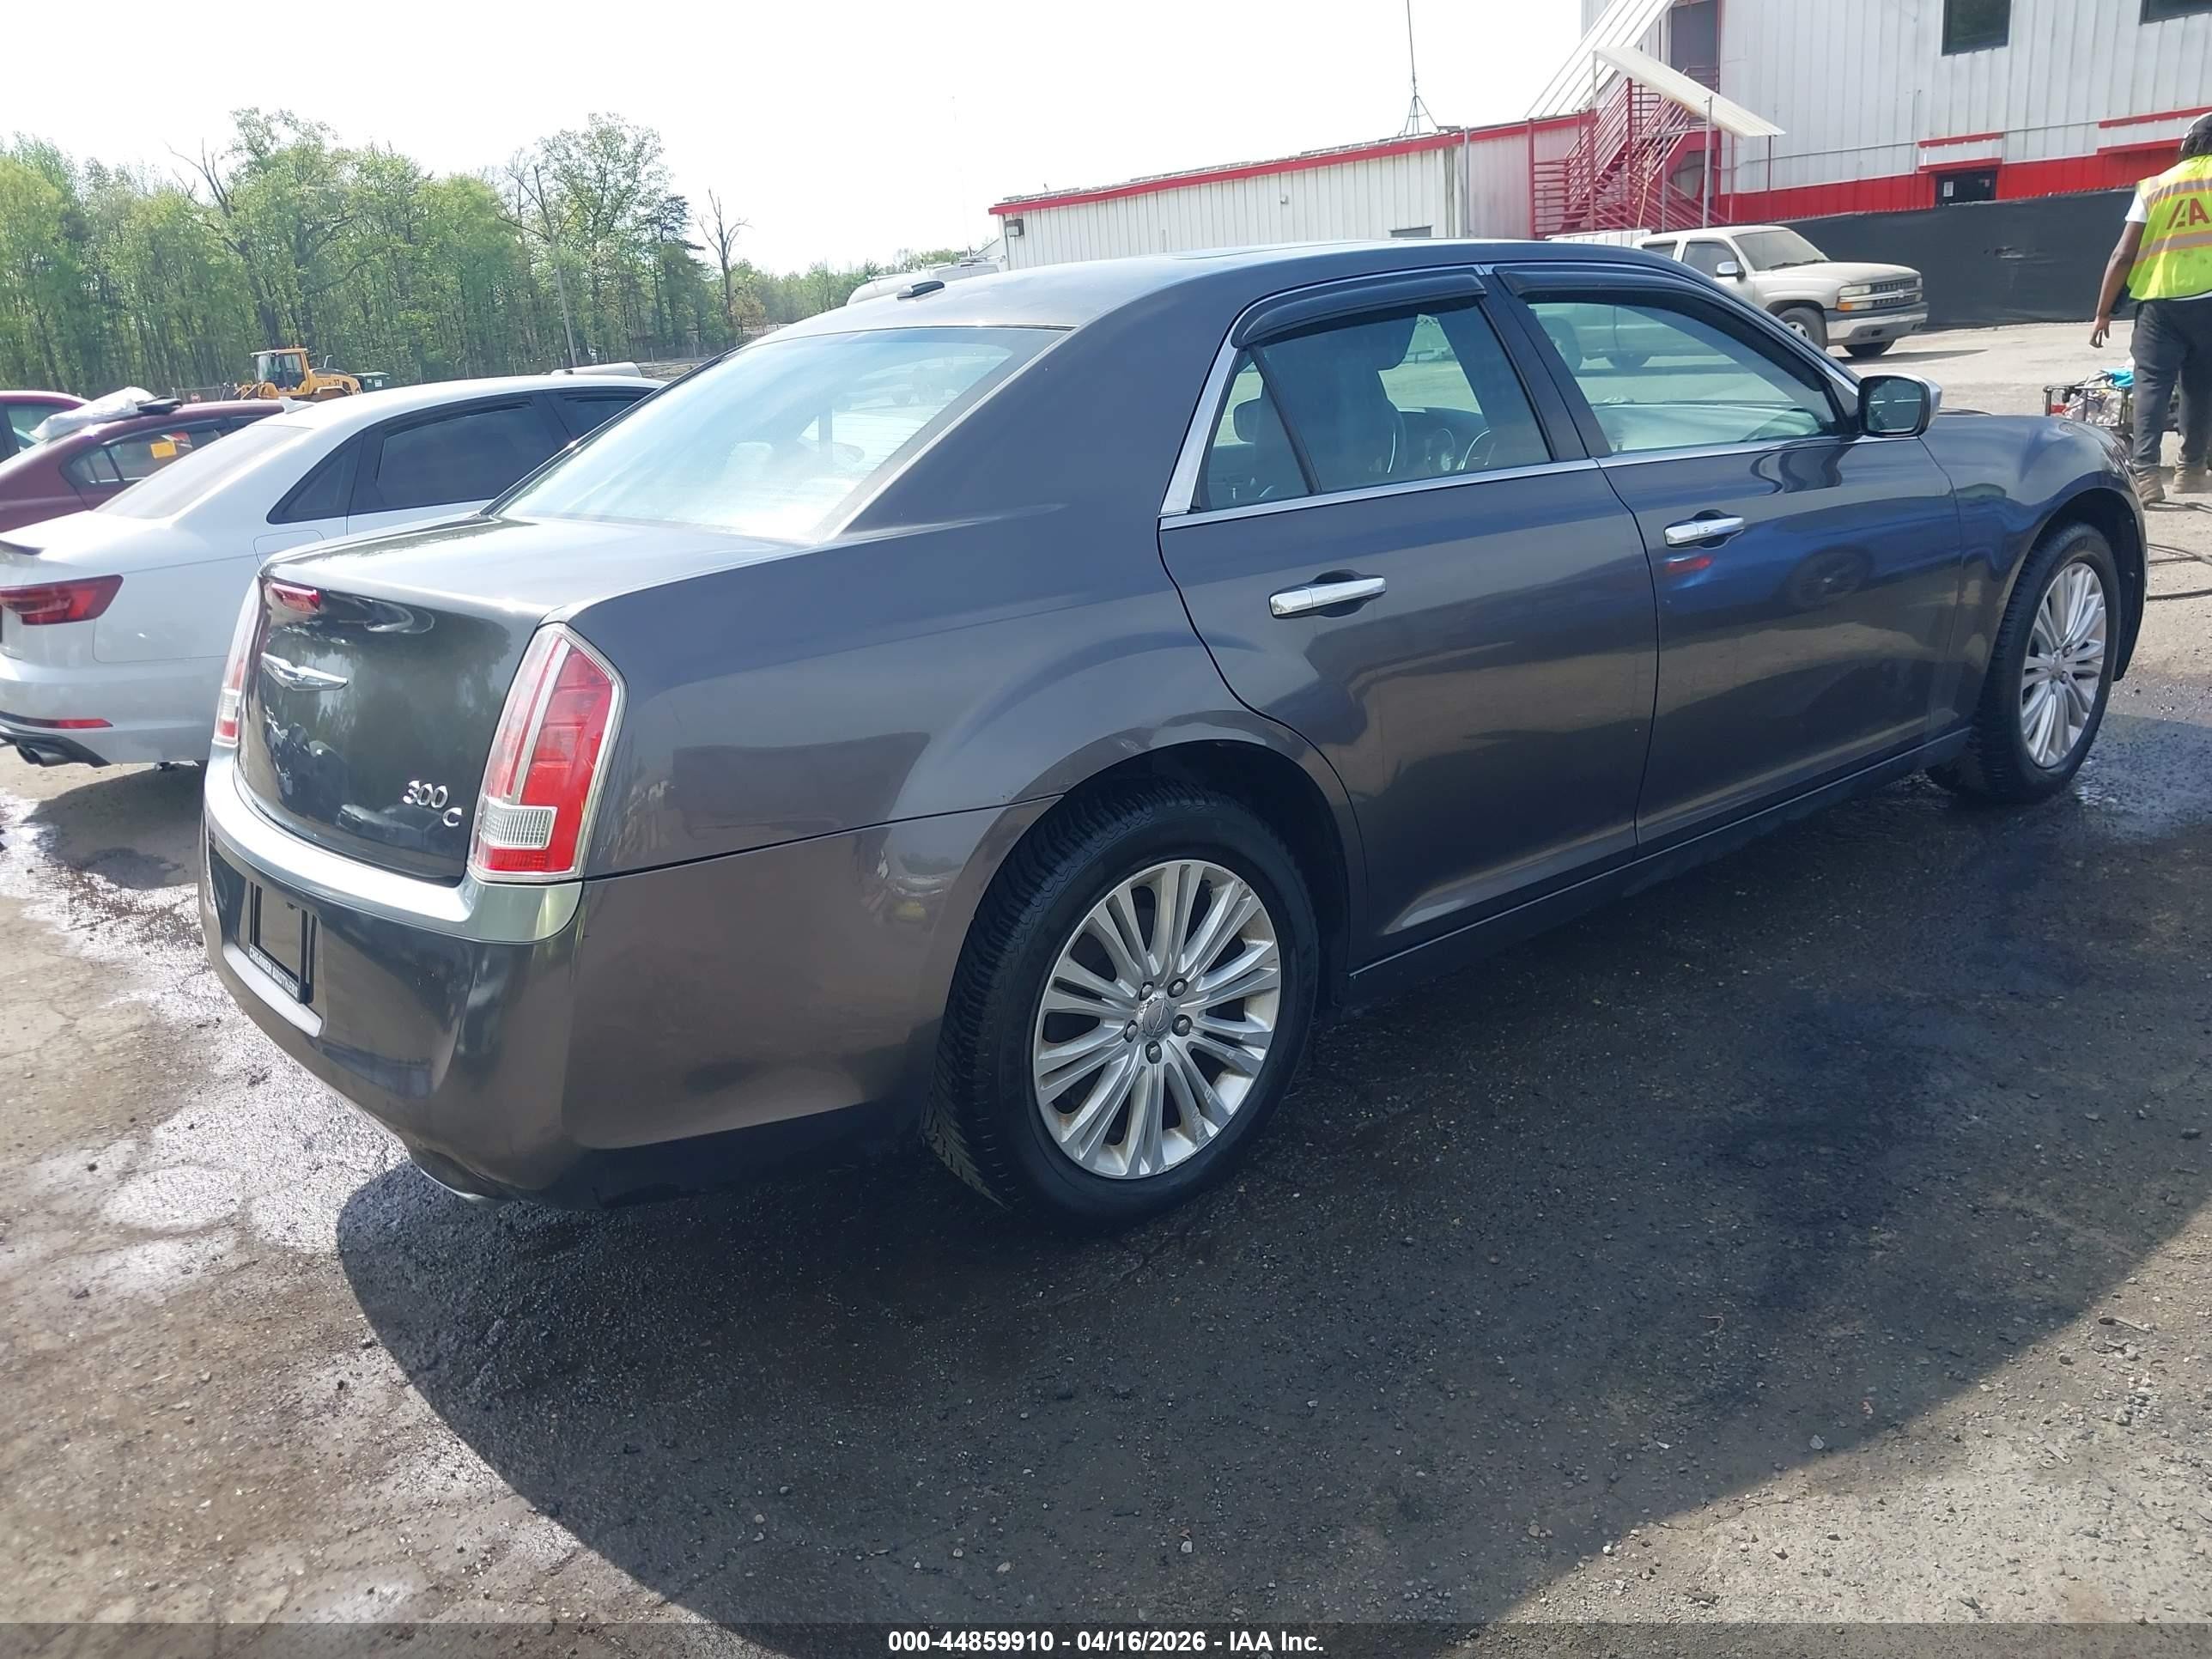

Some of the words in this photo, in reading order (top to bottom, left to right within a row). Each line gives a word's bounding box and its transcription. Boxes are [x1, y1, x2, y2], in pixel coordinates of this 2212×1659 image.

[403, 780, 448, 809] 300
[442, 807, 463, 828] C
[272, 965, 298, 999] BROTHERS
